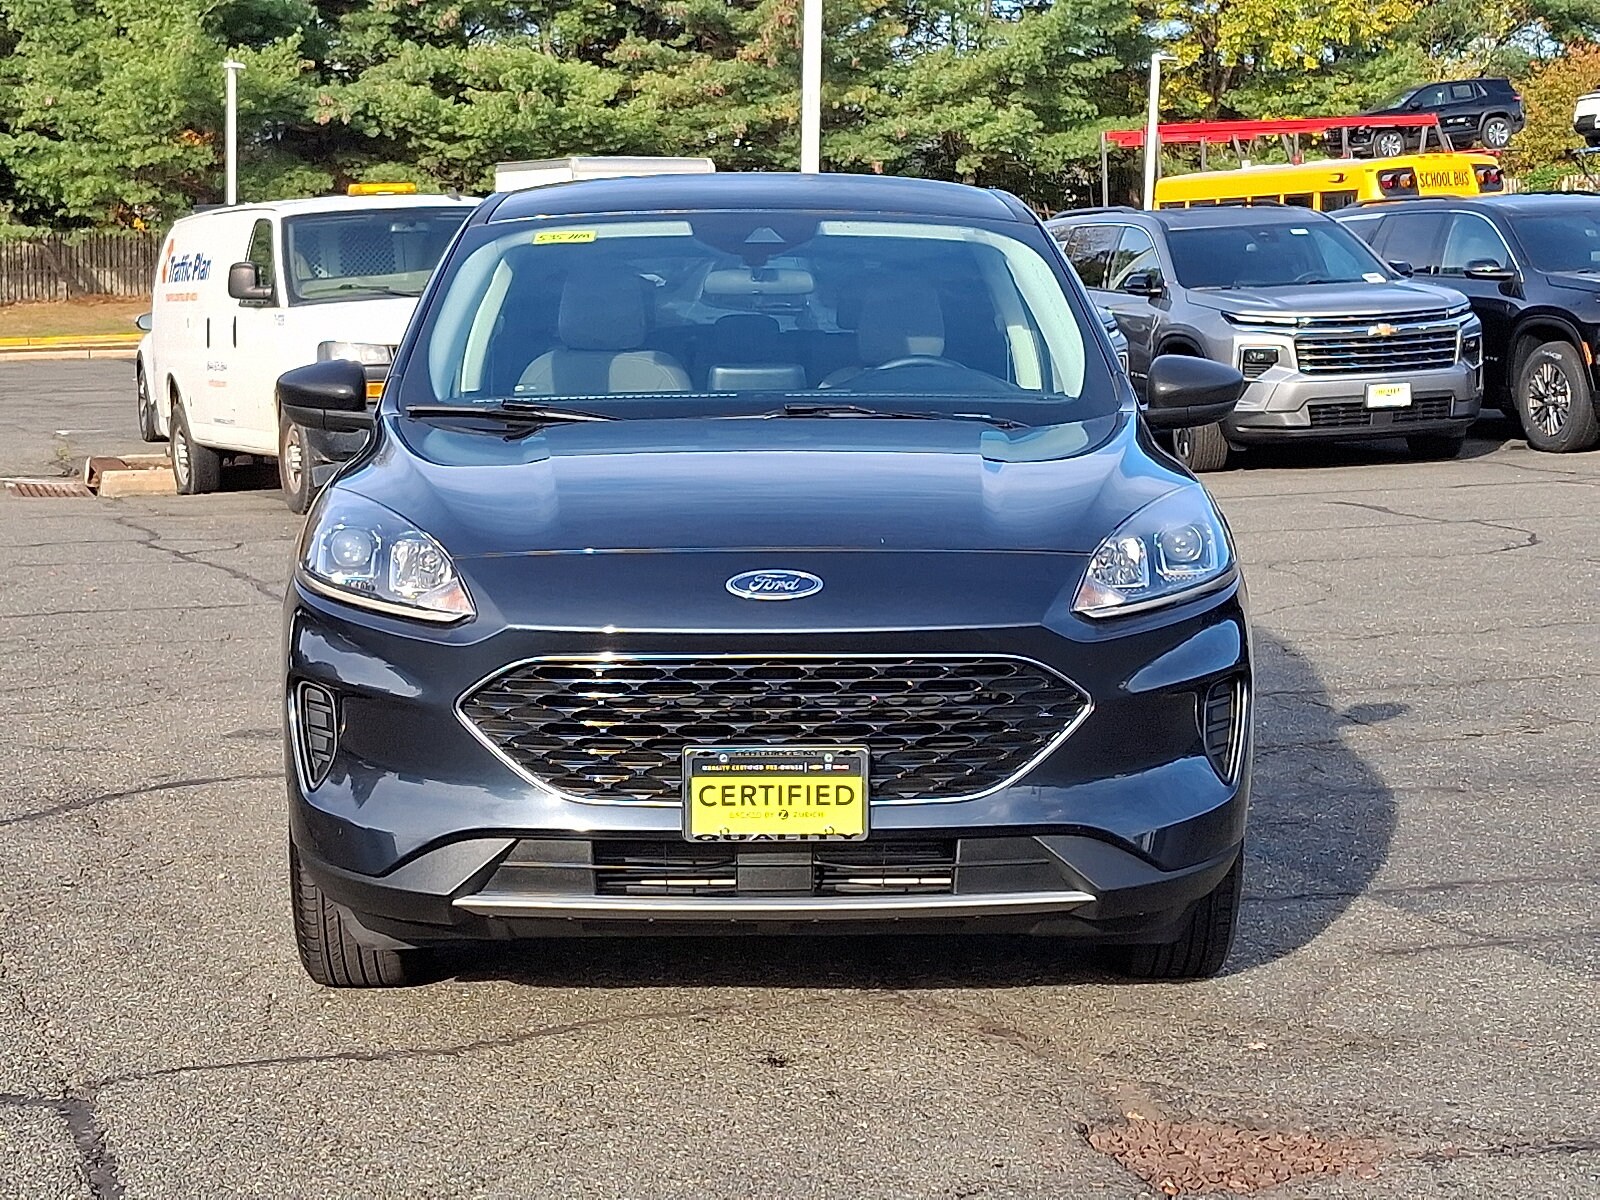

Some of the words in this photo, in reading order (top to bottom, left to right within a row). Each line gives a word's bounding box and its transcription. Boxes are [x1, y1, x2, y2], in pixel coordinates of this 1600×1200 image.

[1419, 171, 1452, 188] SCHOOL
[1453, 171, 1470, 187] BUS
[168, 254, 193, 283] Traffic
[192, 252, 212, 281] Plan
[748, 574, 801, 592] Ford
[699, 785, 855, 807] CERTIFIED
